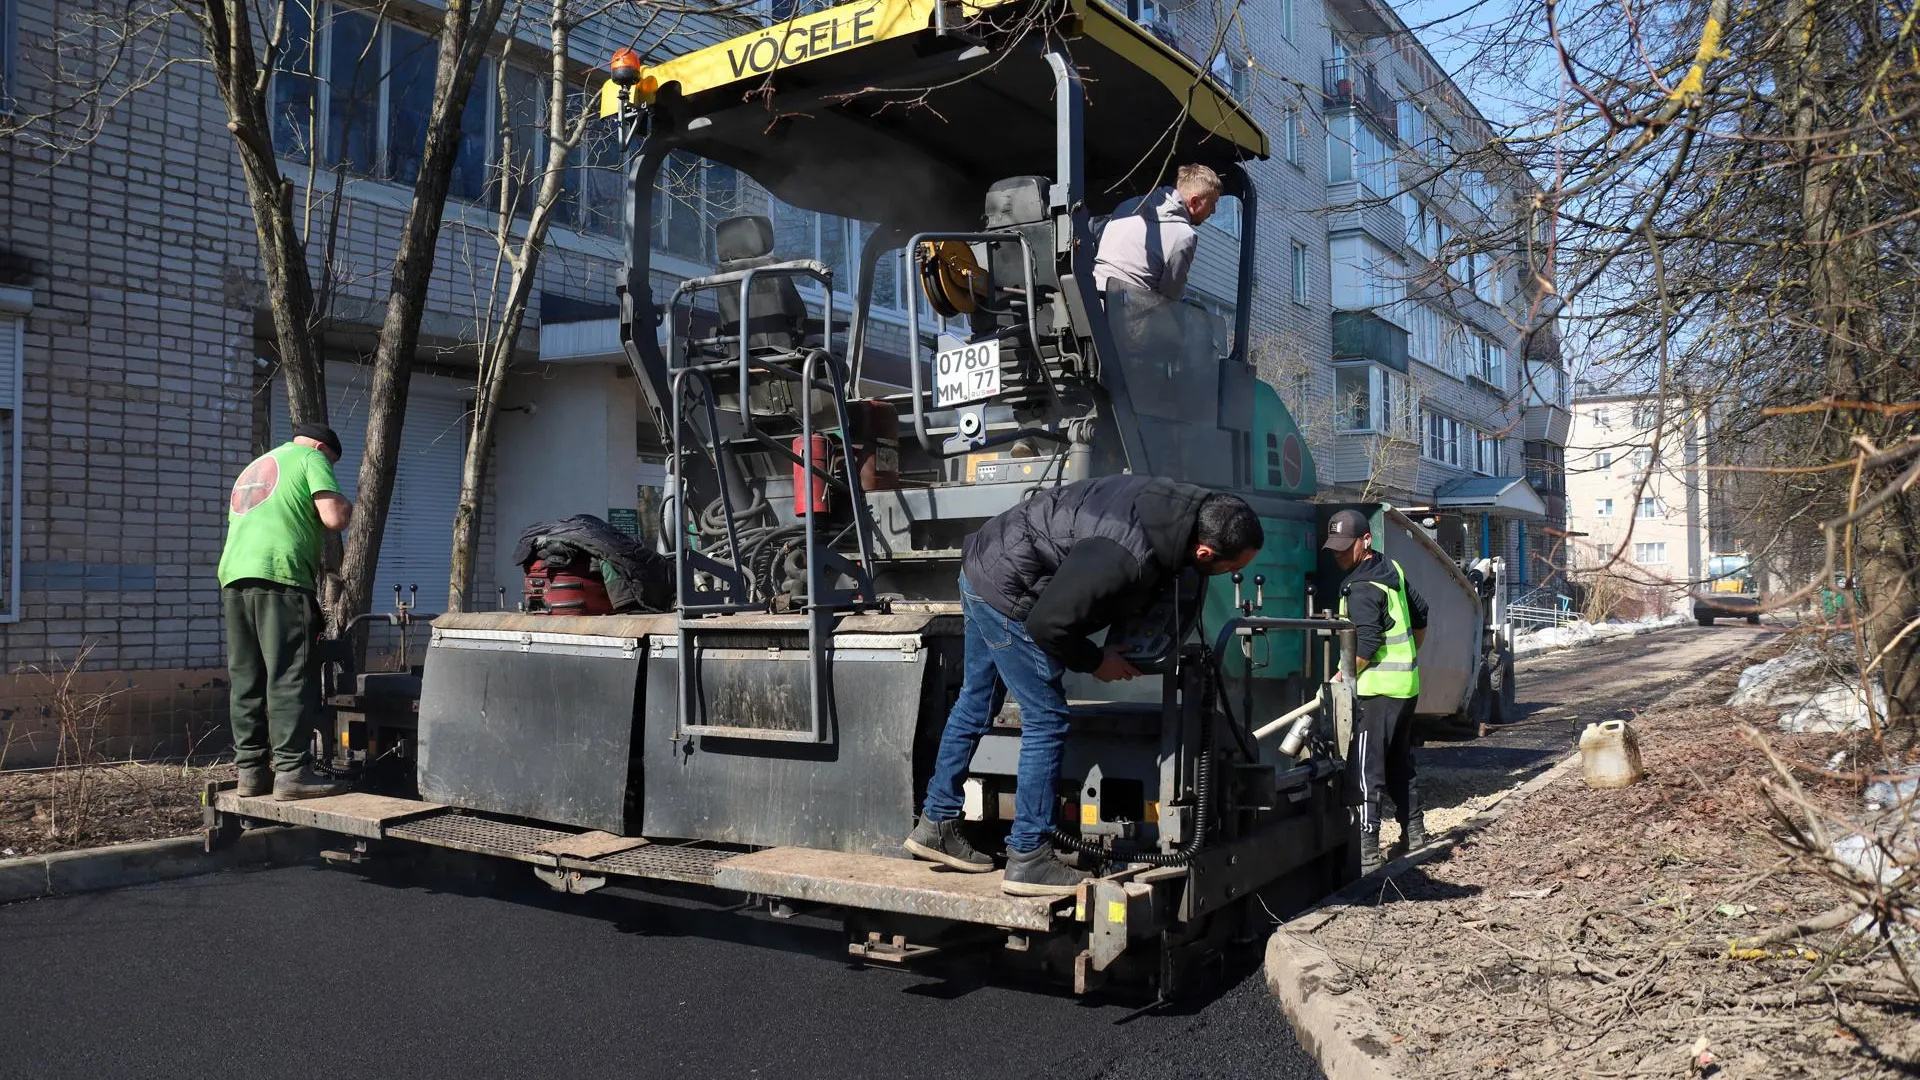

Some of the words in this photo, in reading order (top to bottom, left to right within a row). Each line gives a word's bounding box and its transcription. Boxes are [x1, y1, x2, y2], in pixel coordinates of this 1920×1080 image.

[727, 8, 875, 78] VÖGELE
[940, 346, 989, 375] 0780
[975, 370, 993, 389] 77
[971, 390, 985, 398] RUS
